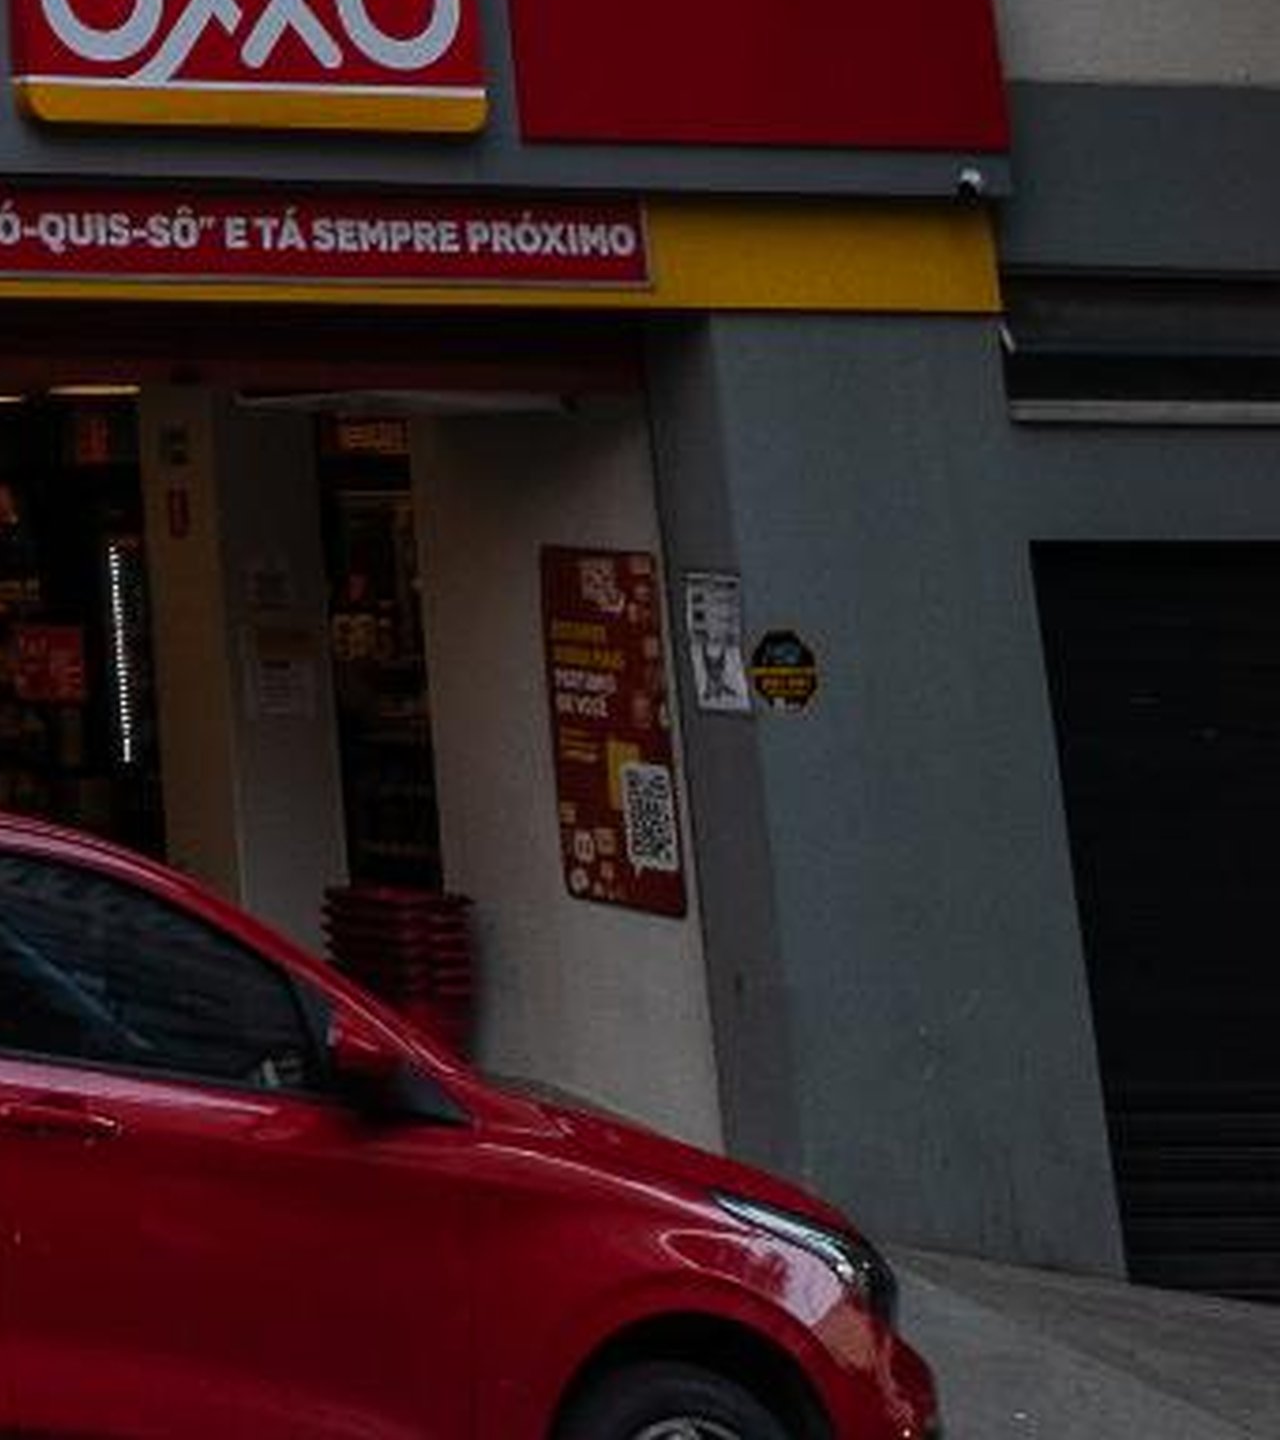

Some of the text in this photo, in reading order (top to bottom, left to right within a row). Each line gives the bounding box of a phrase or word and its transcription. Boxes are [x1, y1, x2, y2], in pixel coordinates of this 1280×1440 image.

[225, 217, 248, 249] E
[255, 207, 307, 251] TÁ
[313, 217, 460, 253] SEMPRE
[467, 211, 636, 257] PRÓXIMO
